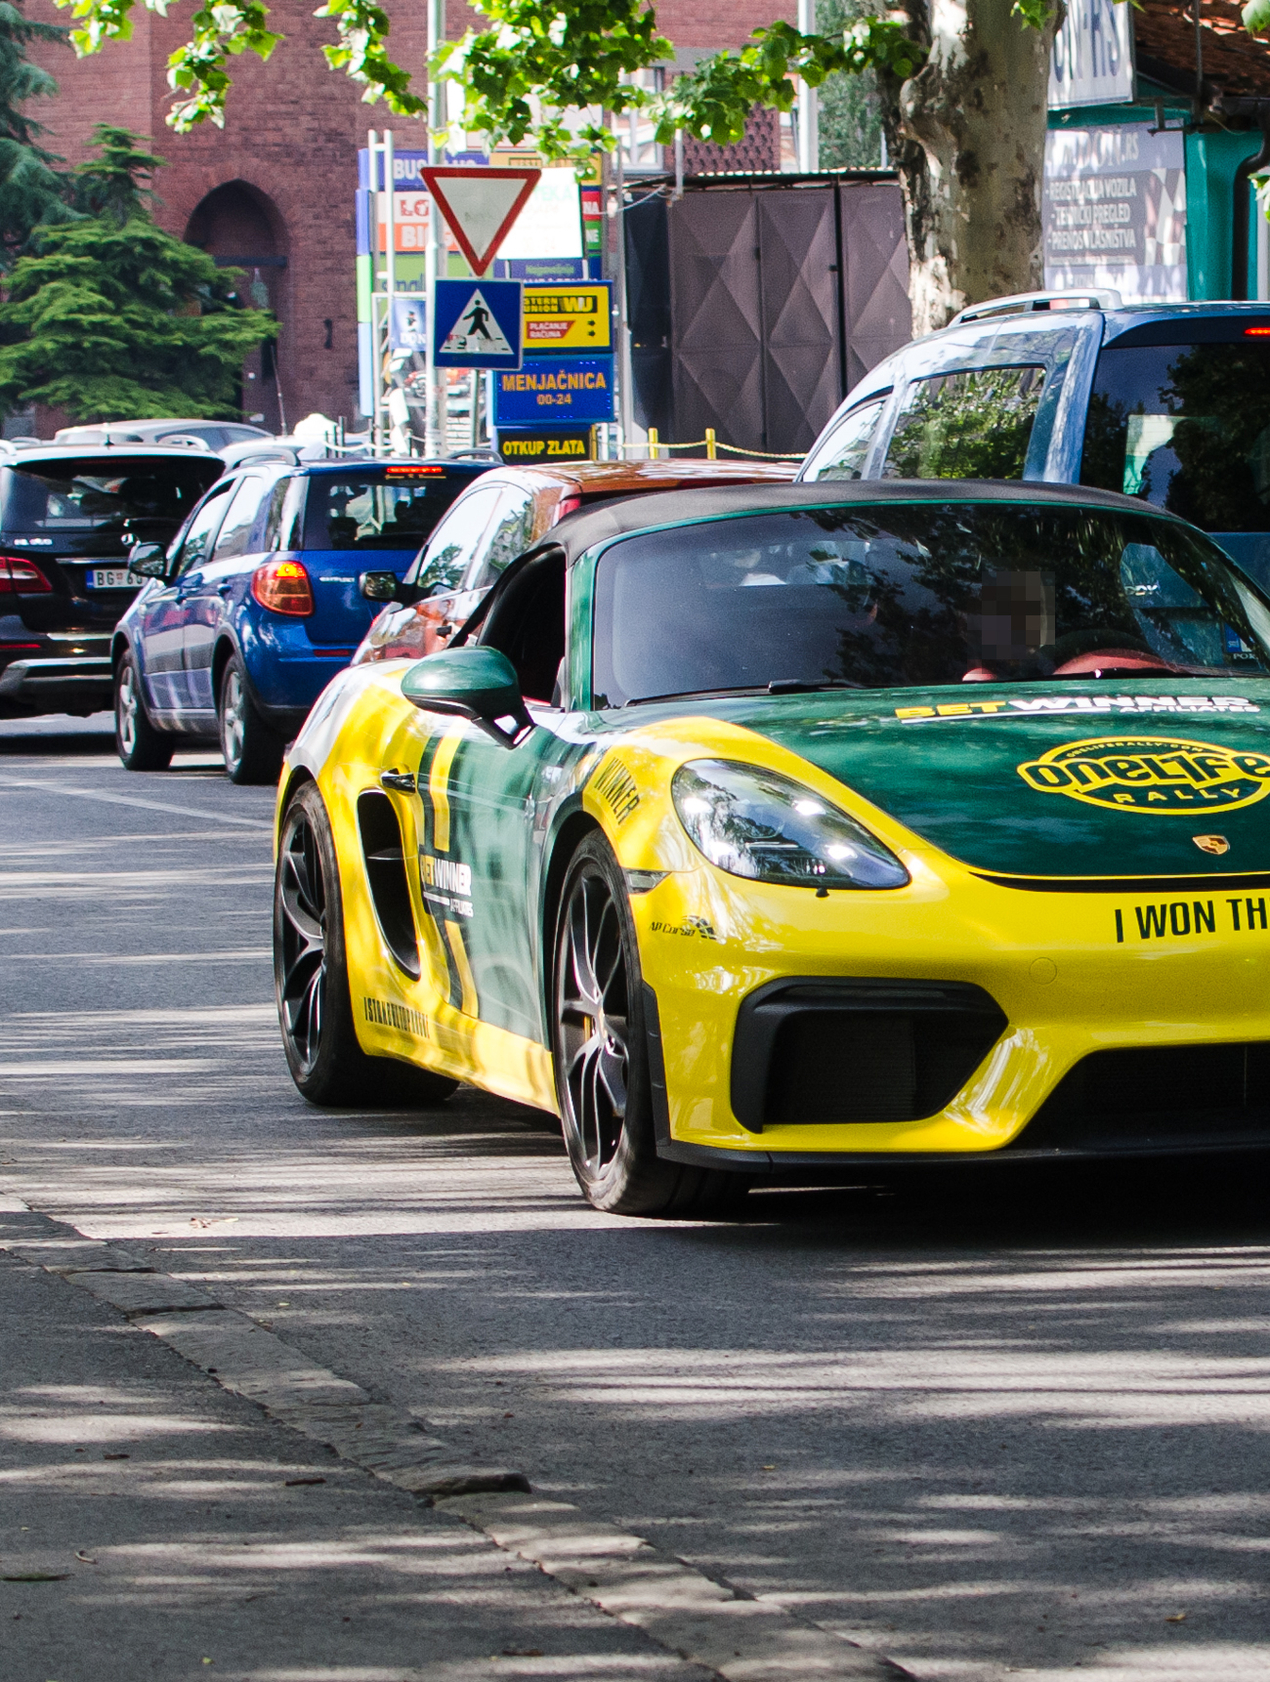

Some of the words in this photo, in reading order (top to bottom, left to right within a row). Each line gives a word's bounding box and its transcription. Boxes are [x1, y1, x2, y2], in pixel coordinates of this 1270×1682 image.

[1104, 177, 1137, 197] VOZILA
[1093, 203, 1131, 224] PREGLED
[502, 369, 606, 391] MENJAČNICA
[536, 393, 572, 405] 00-24
[503, 441, 545, 455] OTKUP
[547, 440, 585, 454] ZLATA
[96, 571, 115, 585] BG
[1119, 705, 1260, 713] AFFILIATES
[1113, 788, 1240, 804] RALLY
[1115, 909, 1124, 943] I
[1135, 900, 1216, 939] WON
